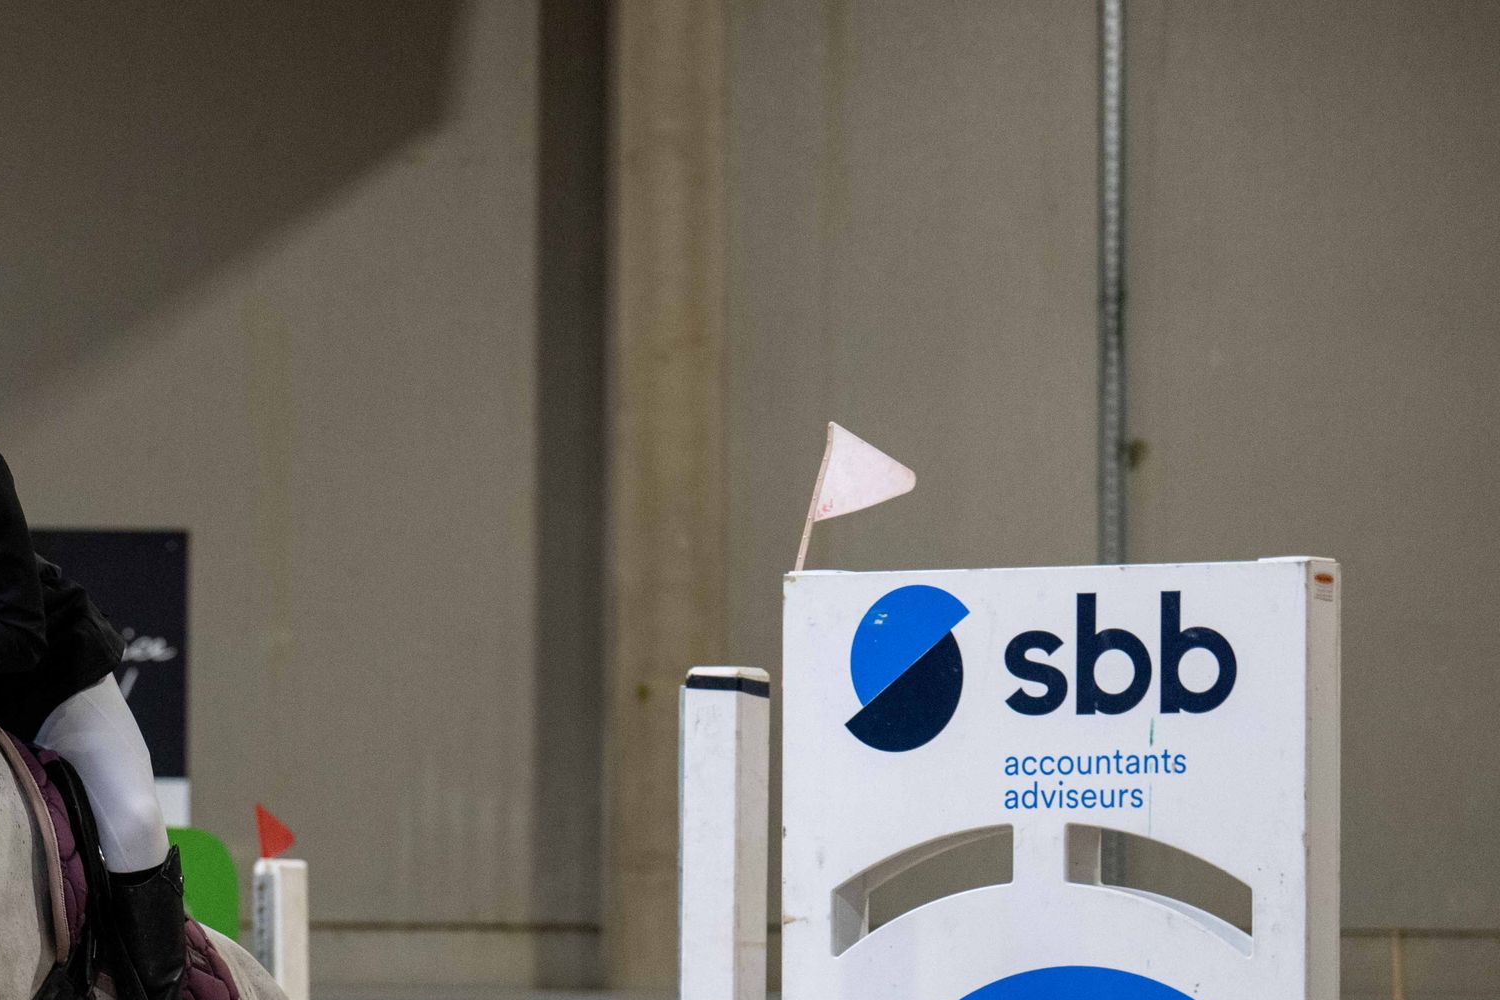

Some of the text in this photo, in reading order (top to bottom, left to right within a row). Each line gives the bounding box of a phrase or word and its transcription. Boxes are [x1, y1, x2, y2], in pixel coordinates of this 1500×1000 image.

[1004, 590, 1238, 716] sbb
[1004, 749, 1188, 776] accountants
[1004, 780, 1144, 810] adviseurs
